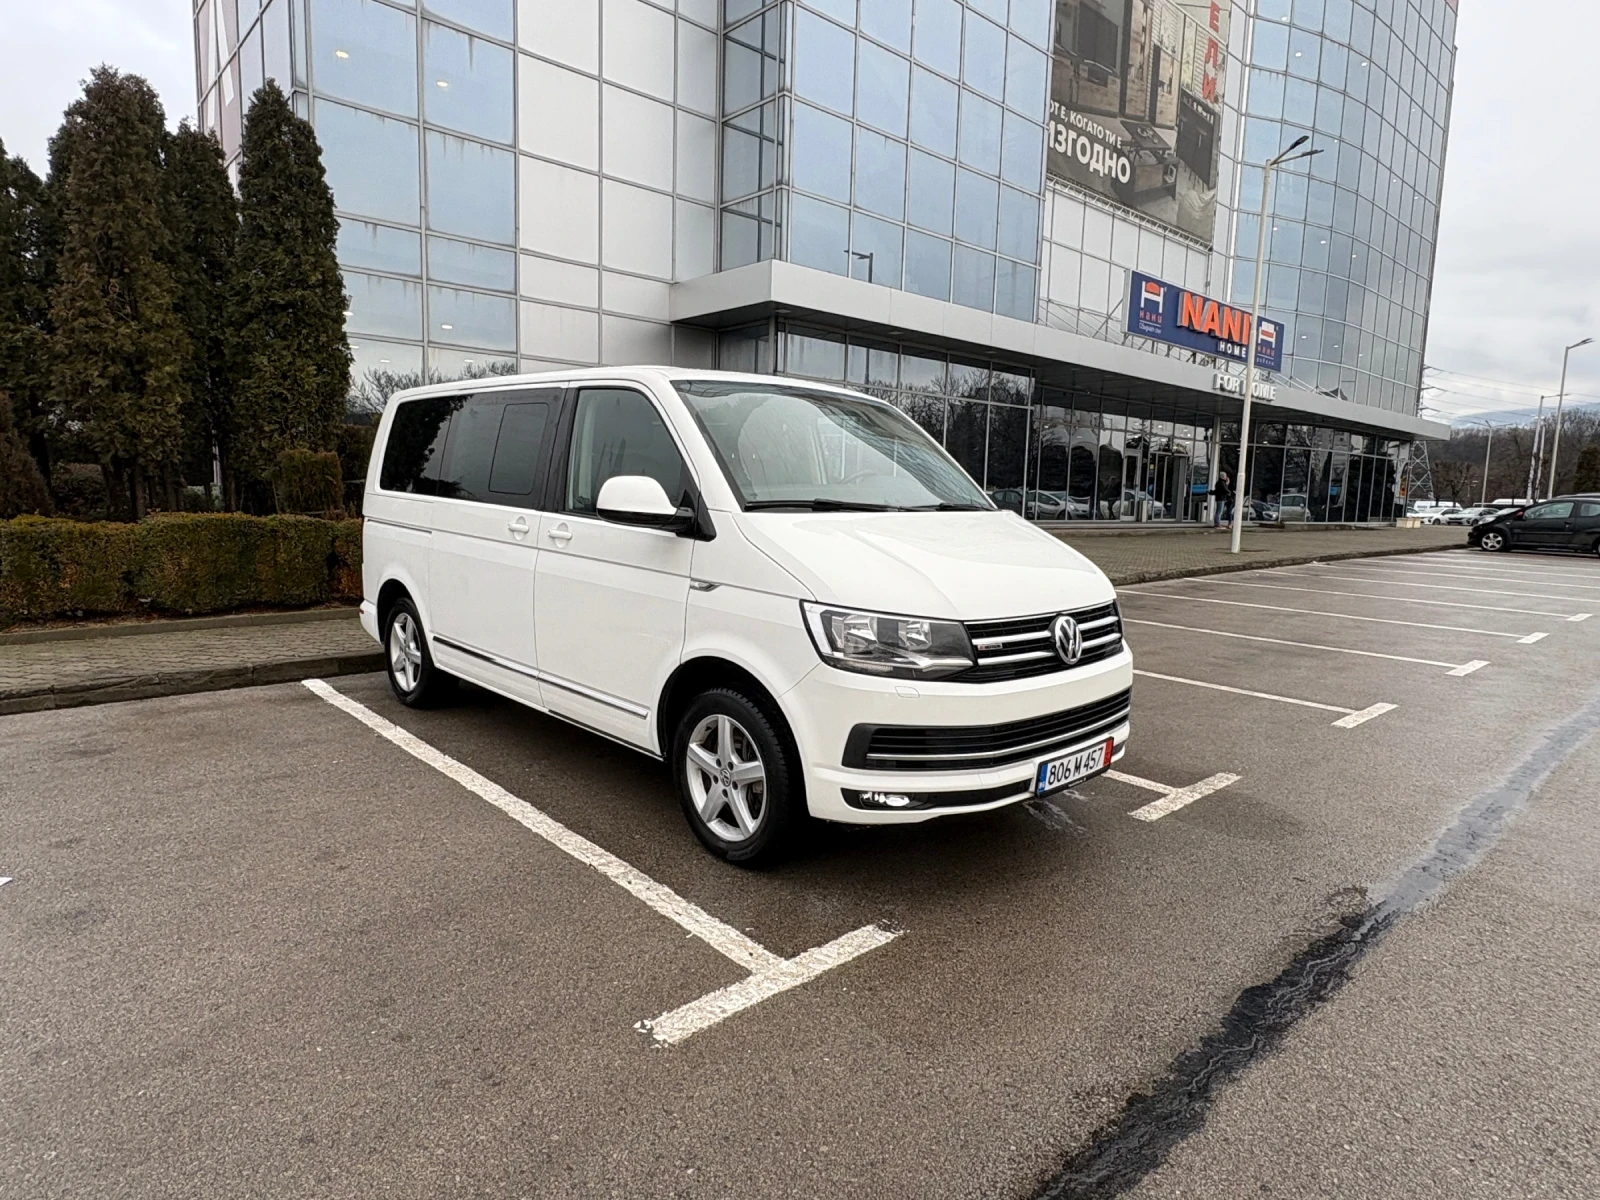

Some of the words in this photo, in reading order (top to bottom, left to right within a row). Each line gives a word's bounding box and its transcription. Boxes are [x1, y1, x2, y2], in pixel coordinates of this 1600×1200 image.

[1070, 110, 1104, 139] КОГАТО
[1105, 129, 1116, 146] ТИ
[1117, 135, 1122, 149] Е
[1218, 341, 1247, 358] HOME
[1214, 374, 1240, 392] FOR
[1048, 760, 1072, 785] 806
[1073, 755, 1083, 777] M
[1083, 746, 1104, 772] 457
